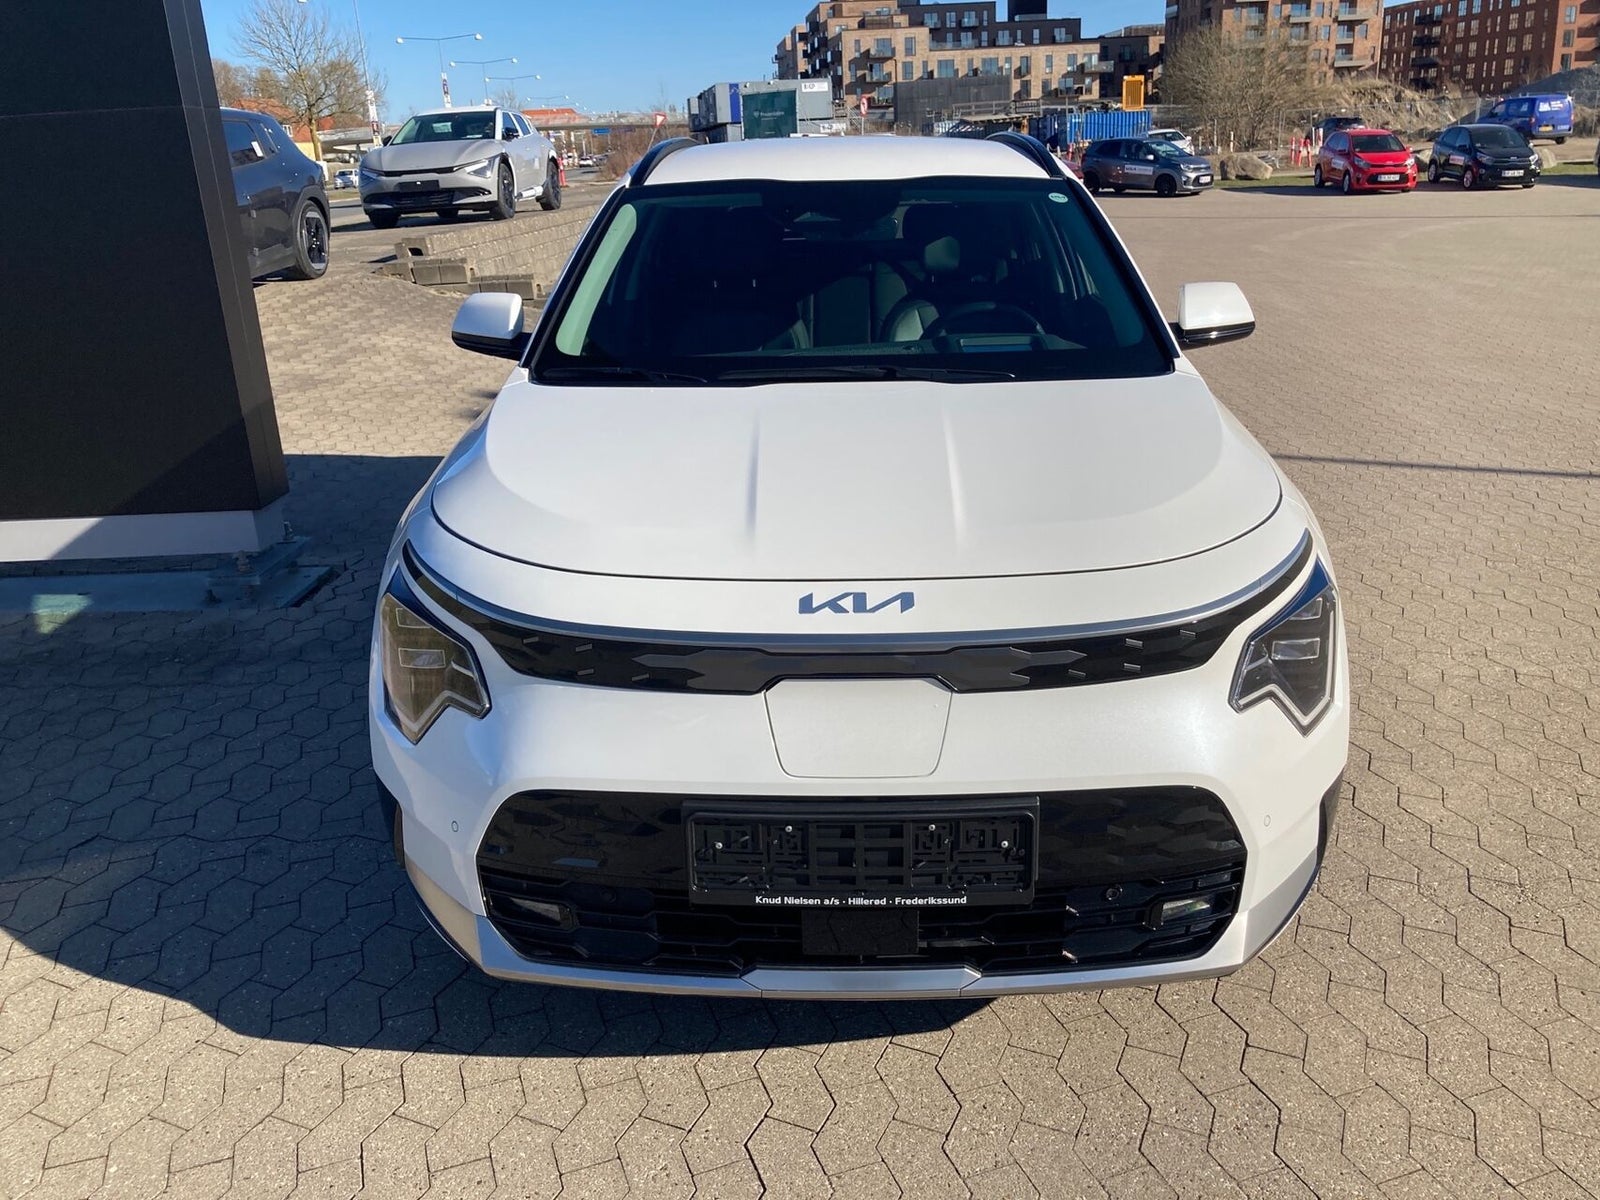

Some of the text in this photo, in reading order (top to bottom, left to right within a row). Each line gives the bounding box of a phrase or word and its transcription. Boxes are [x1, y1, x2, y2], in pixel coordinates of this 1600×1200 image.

[799, 592, 914, 614] KIA
[755, 895, 967, 906] Knud Nielsen a/s Hillerød Frederikssund
